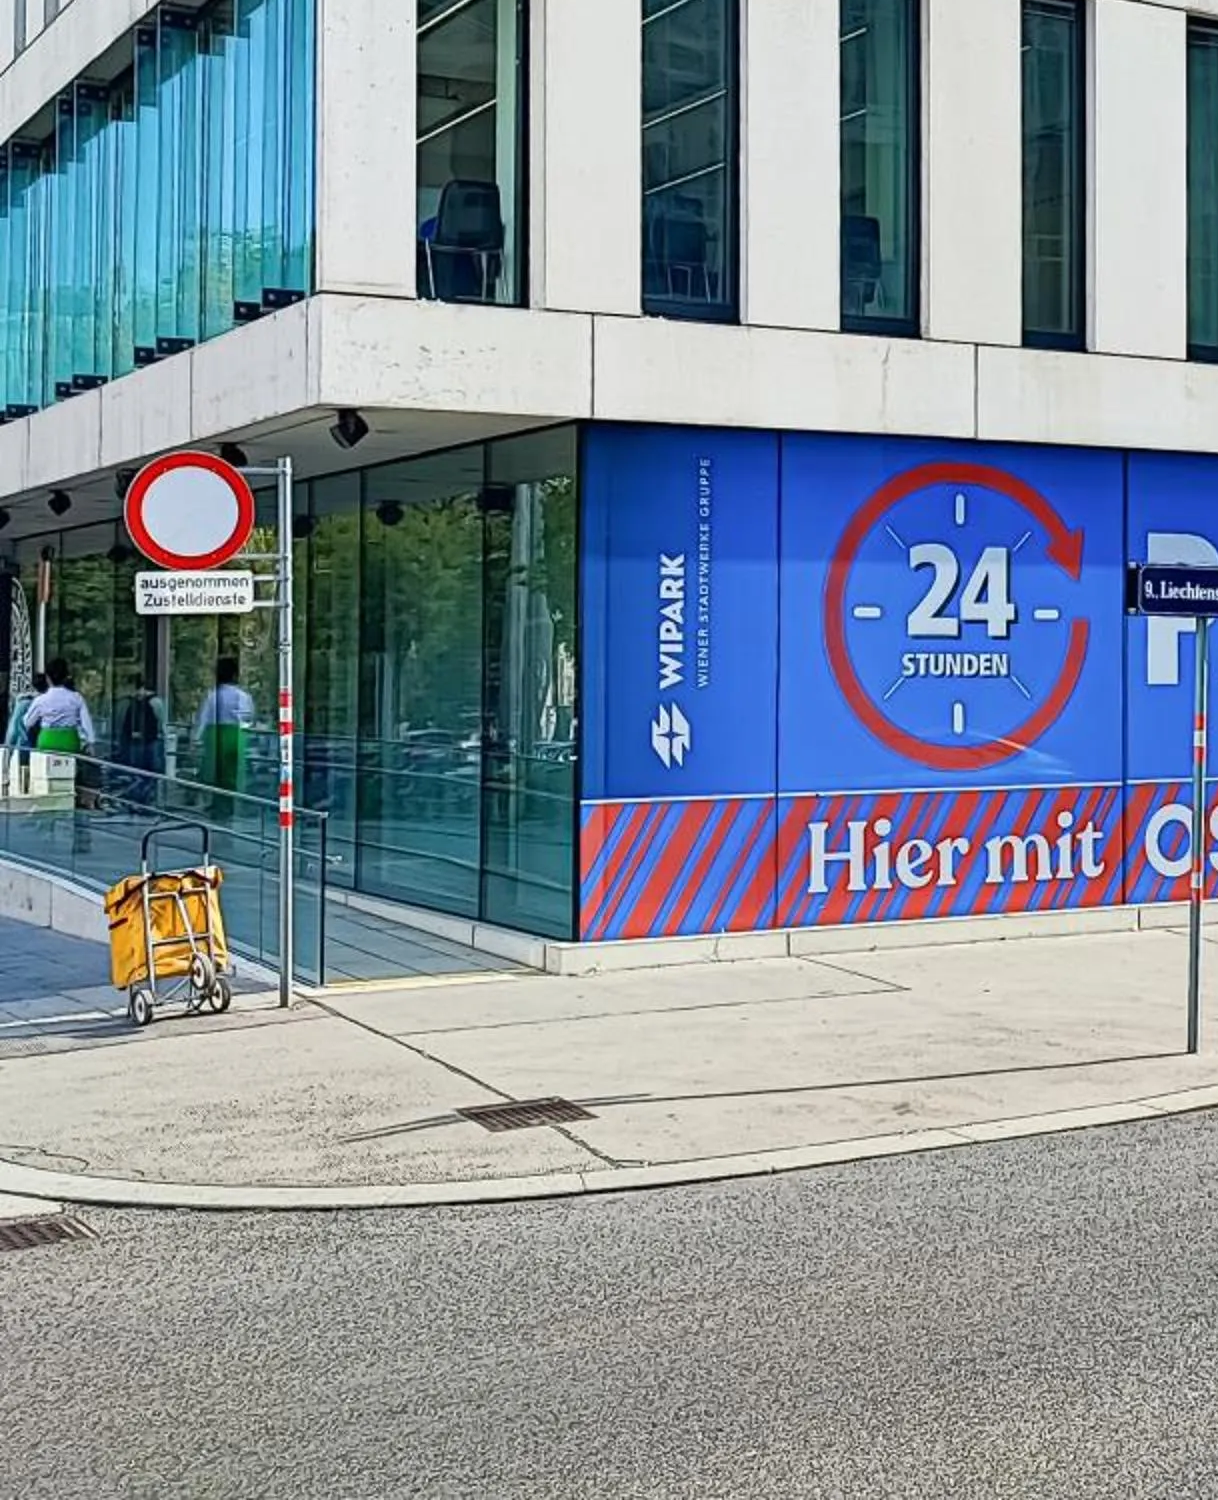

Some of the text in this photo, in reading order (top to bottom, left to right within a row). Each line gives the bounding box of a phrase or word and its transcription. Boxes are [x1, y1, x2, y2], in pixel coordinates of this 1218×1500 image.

[141, 577, 250, 592] ausgenommen
[143, 593, 248, 607] Zustelldienste
[697, 457, 712, 688] WIENER STADTWERKE GRUPPE
[907, 543, 1016, 637] 24
[659, 553, 685, 690] WIPARK
[901, 652, 1009, 677] STUNDEN
[806, 815, 968, 894] Hier
[984, 810, 1105, 882] mit
